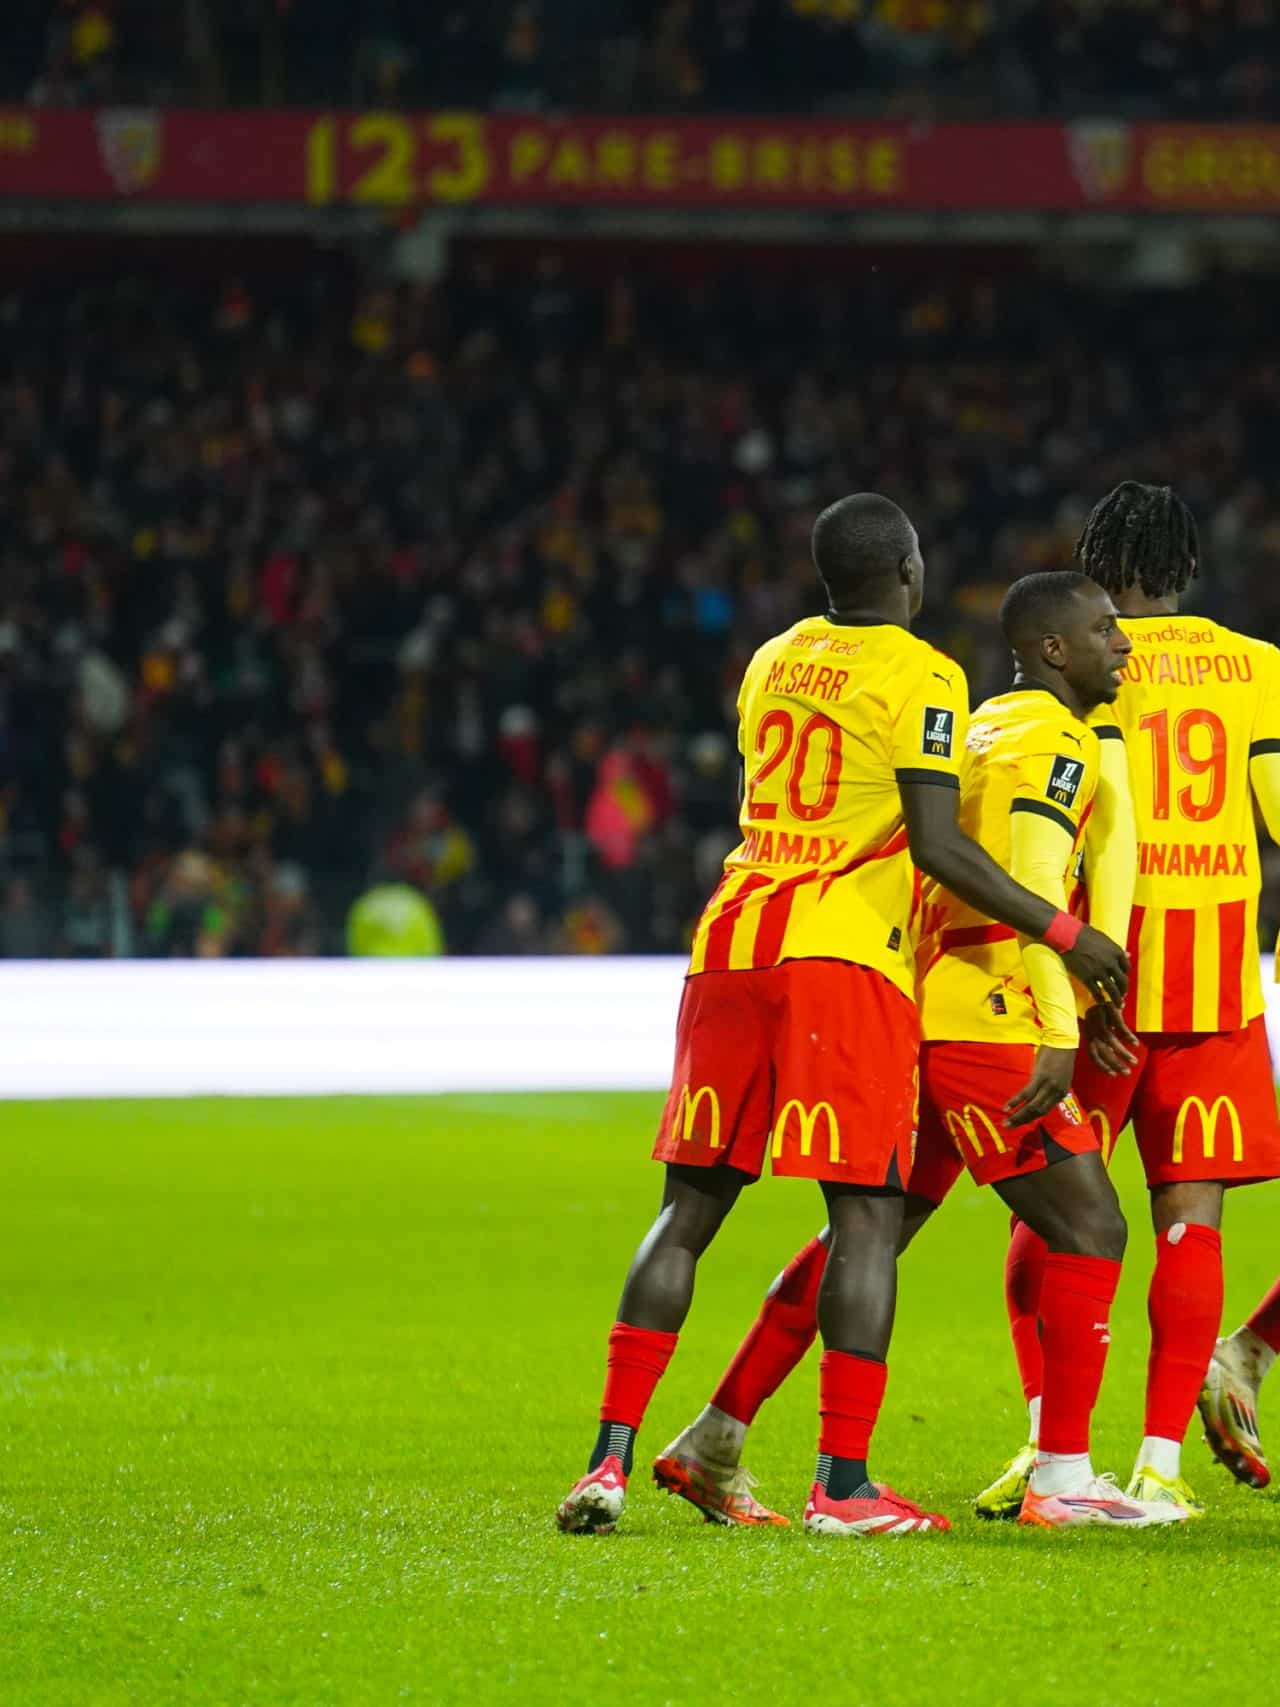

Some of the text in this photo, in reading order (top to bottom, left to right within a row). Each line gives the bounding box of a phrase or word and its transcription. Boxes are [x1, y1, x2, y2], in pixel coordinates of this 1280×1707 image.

[306, 112, 490, 205] 123
[765, 660, 849, 701] M.SARR
[1120, 654, 1252, 686] OYALIPOU
[749, 708, 843, 822] 20
[1139, 708, 1227, 822] 19
[1137, 842, 1248, 877] INAMAX
